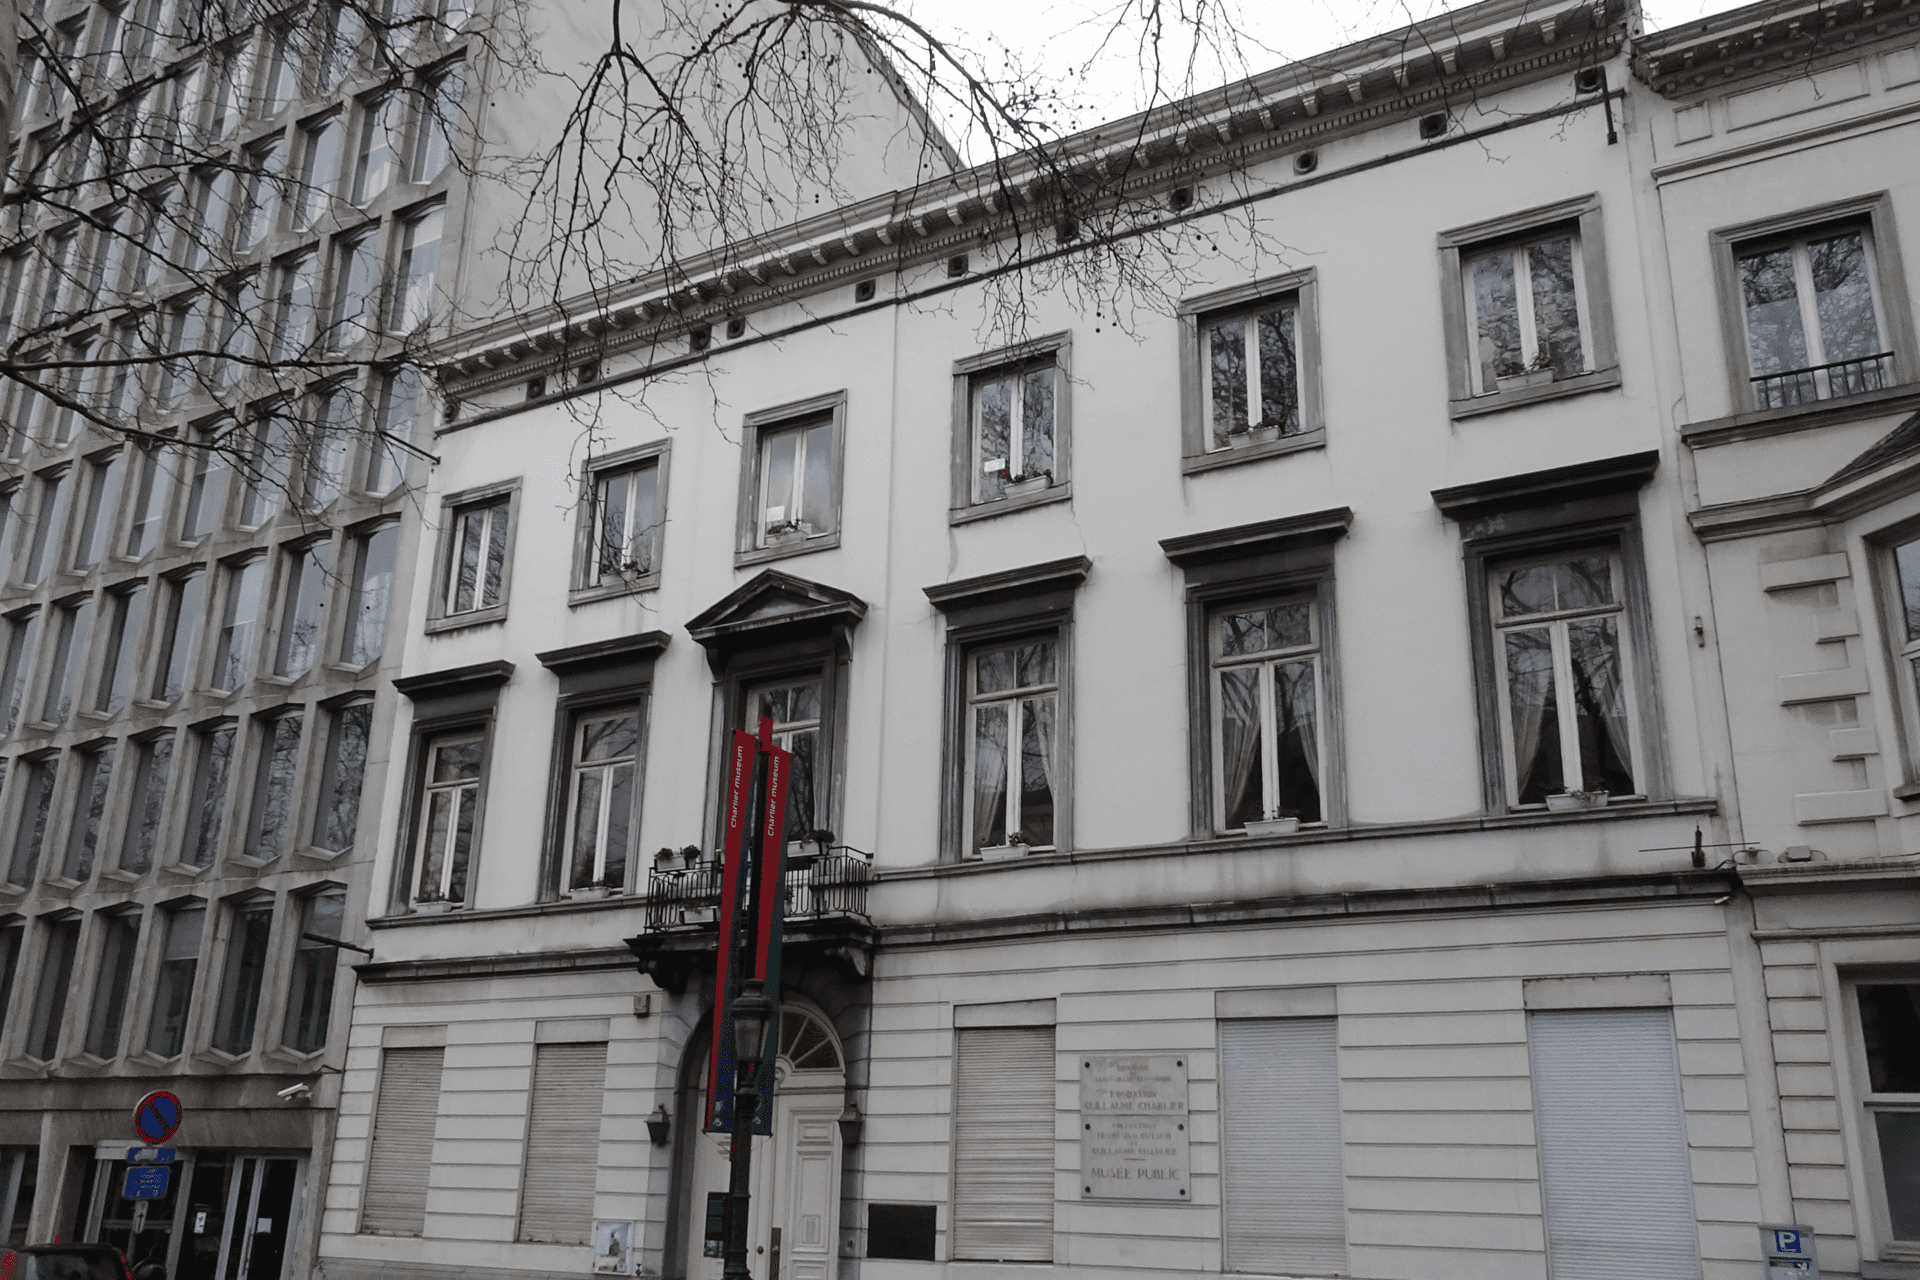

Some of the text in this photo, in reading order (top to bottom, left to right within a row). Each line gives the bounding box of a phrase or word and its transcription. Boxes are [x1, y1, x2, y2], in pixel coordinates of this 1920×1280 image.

[730, 745, 743, 829] Charlier museum
[767, 755, 780, 837] Charlier museum
[1138, 1101, 1184, 1111] CHARLIER
[1778, 1231, 1796, 1250] P
